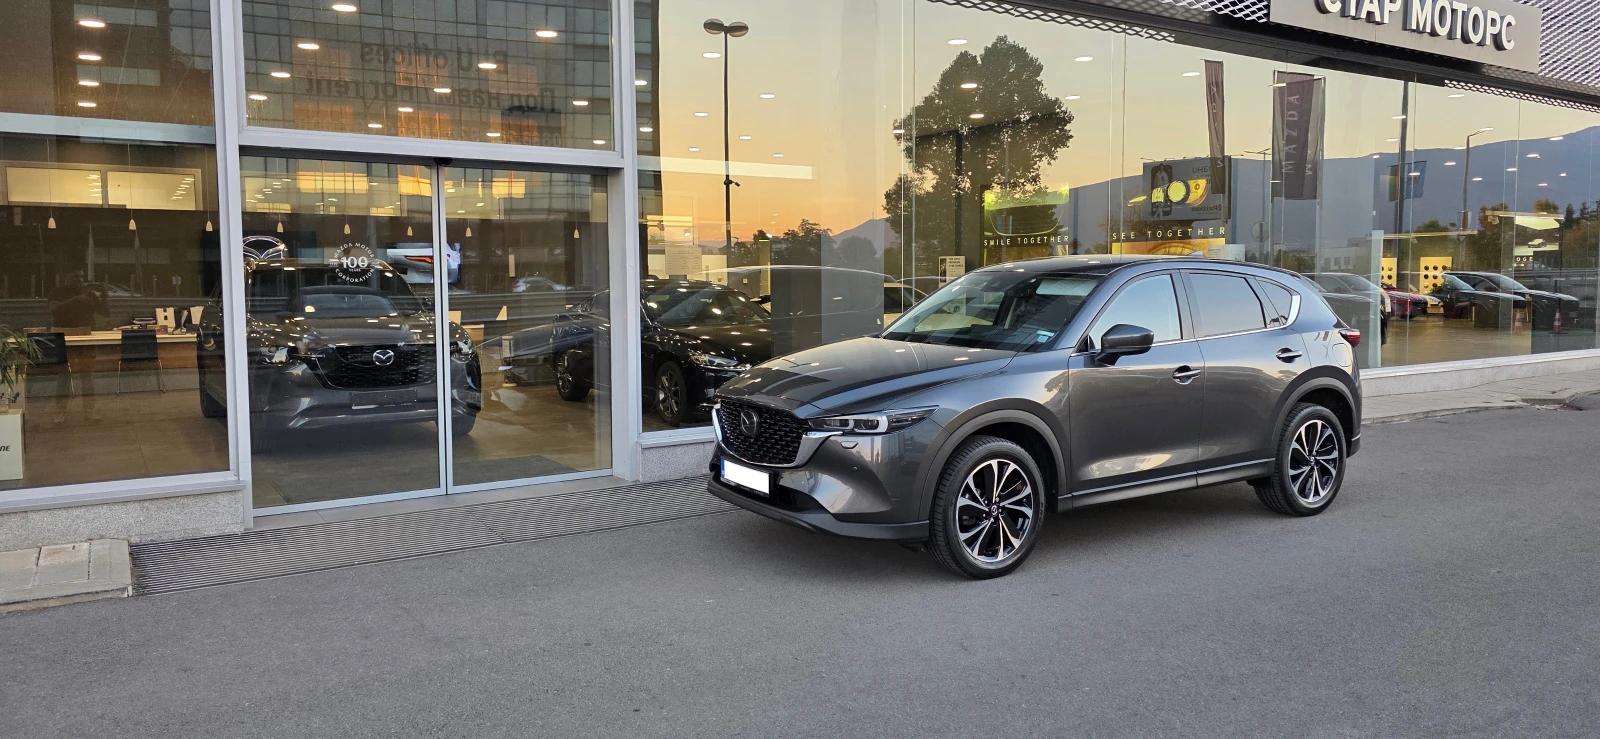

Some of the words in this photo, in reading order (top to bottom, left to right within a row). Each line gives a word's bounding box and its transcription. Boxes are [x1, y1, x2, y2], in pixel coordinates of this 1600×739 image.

[1406, 0, 1516, 50] МОТОРС
[1281, 95, 1300, 173] MAZDA
[984, 238, 1011, 246] SMILE
[1017, 235, 1069, 245] TOGETHER
[1112, 232, 1136, 240] SEE
[1147, 227, 1226, 238] TOGETHER
[333, 242, 353, 258] MAZDA
[354, 242, 375, 258] MOTOR
[340, 256, 368, 269] 100
[335, 268, 375, 283] CORPORATION
